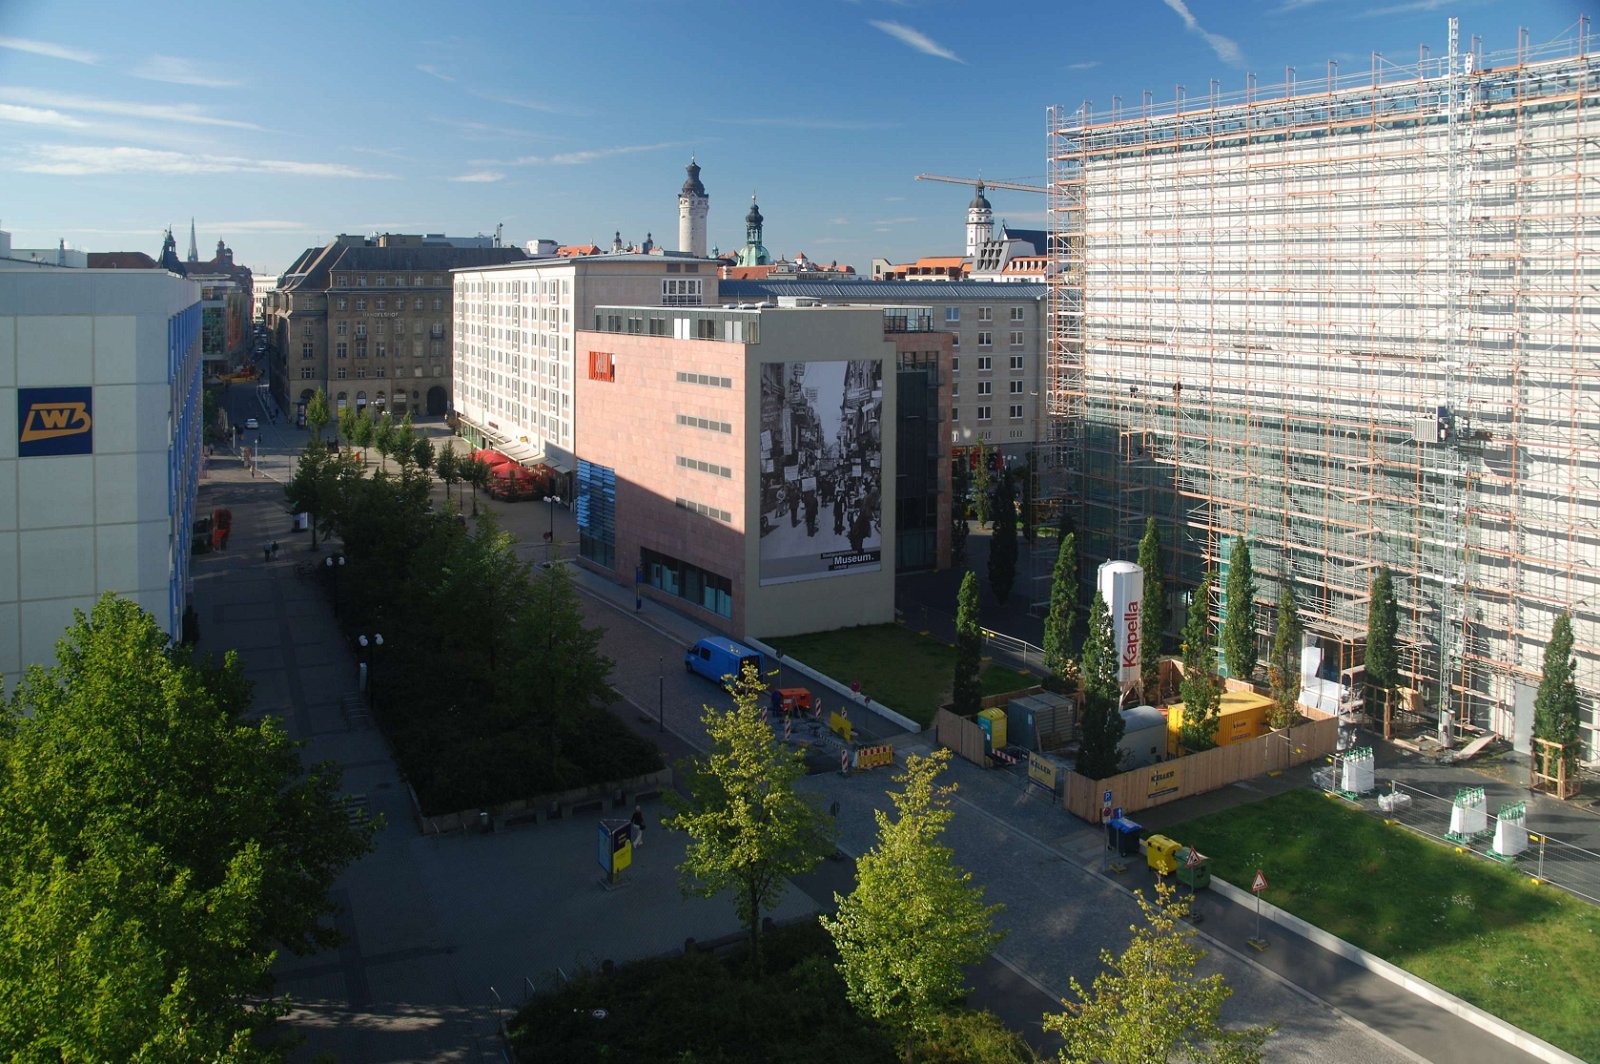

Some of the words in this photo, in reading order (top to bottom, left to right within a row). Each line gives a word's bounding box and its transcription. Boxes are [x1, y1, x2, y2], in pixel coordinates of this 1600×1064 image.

[1122, 601, 1139, 668] Kapella
[1031, 759, 1052, 775] KELLER
[1151, 770, 1175, 782] KELLER
